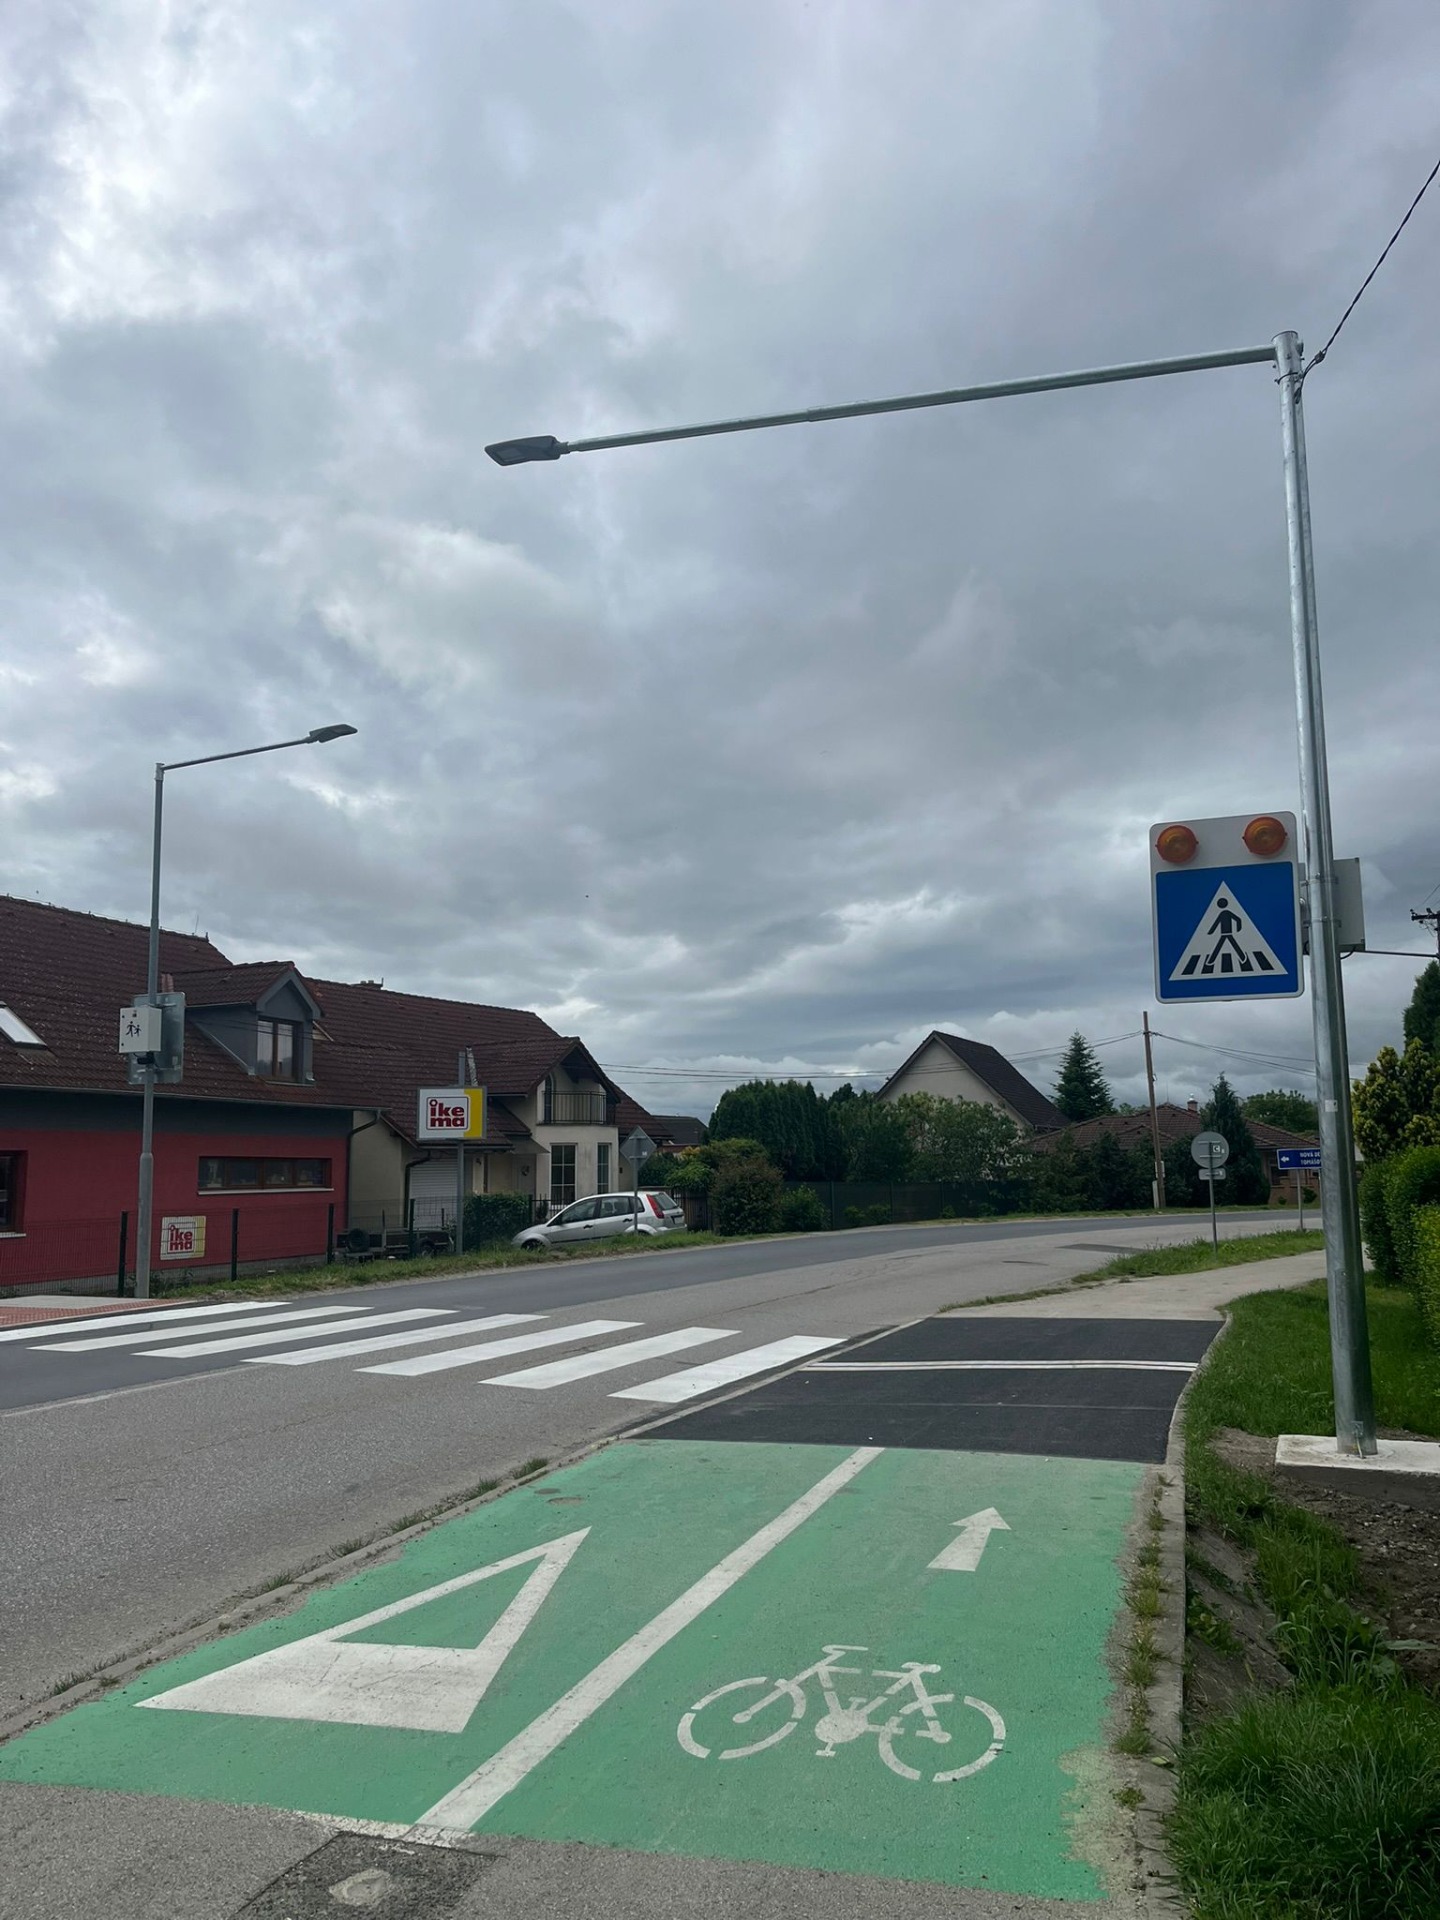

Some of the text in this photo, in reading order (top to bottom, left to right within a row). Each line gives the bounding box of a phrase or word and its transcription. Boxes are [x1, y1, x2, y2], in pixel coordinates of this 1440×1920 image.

[429, 1099, 465, 1117] ike
[430, 1117, 465, 1127] ma
[170, 1224, 193, 1241] ike
[170, 1241, 193, 1250] ma
